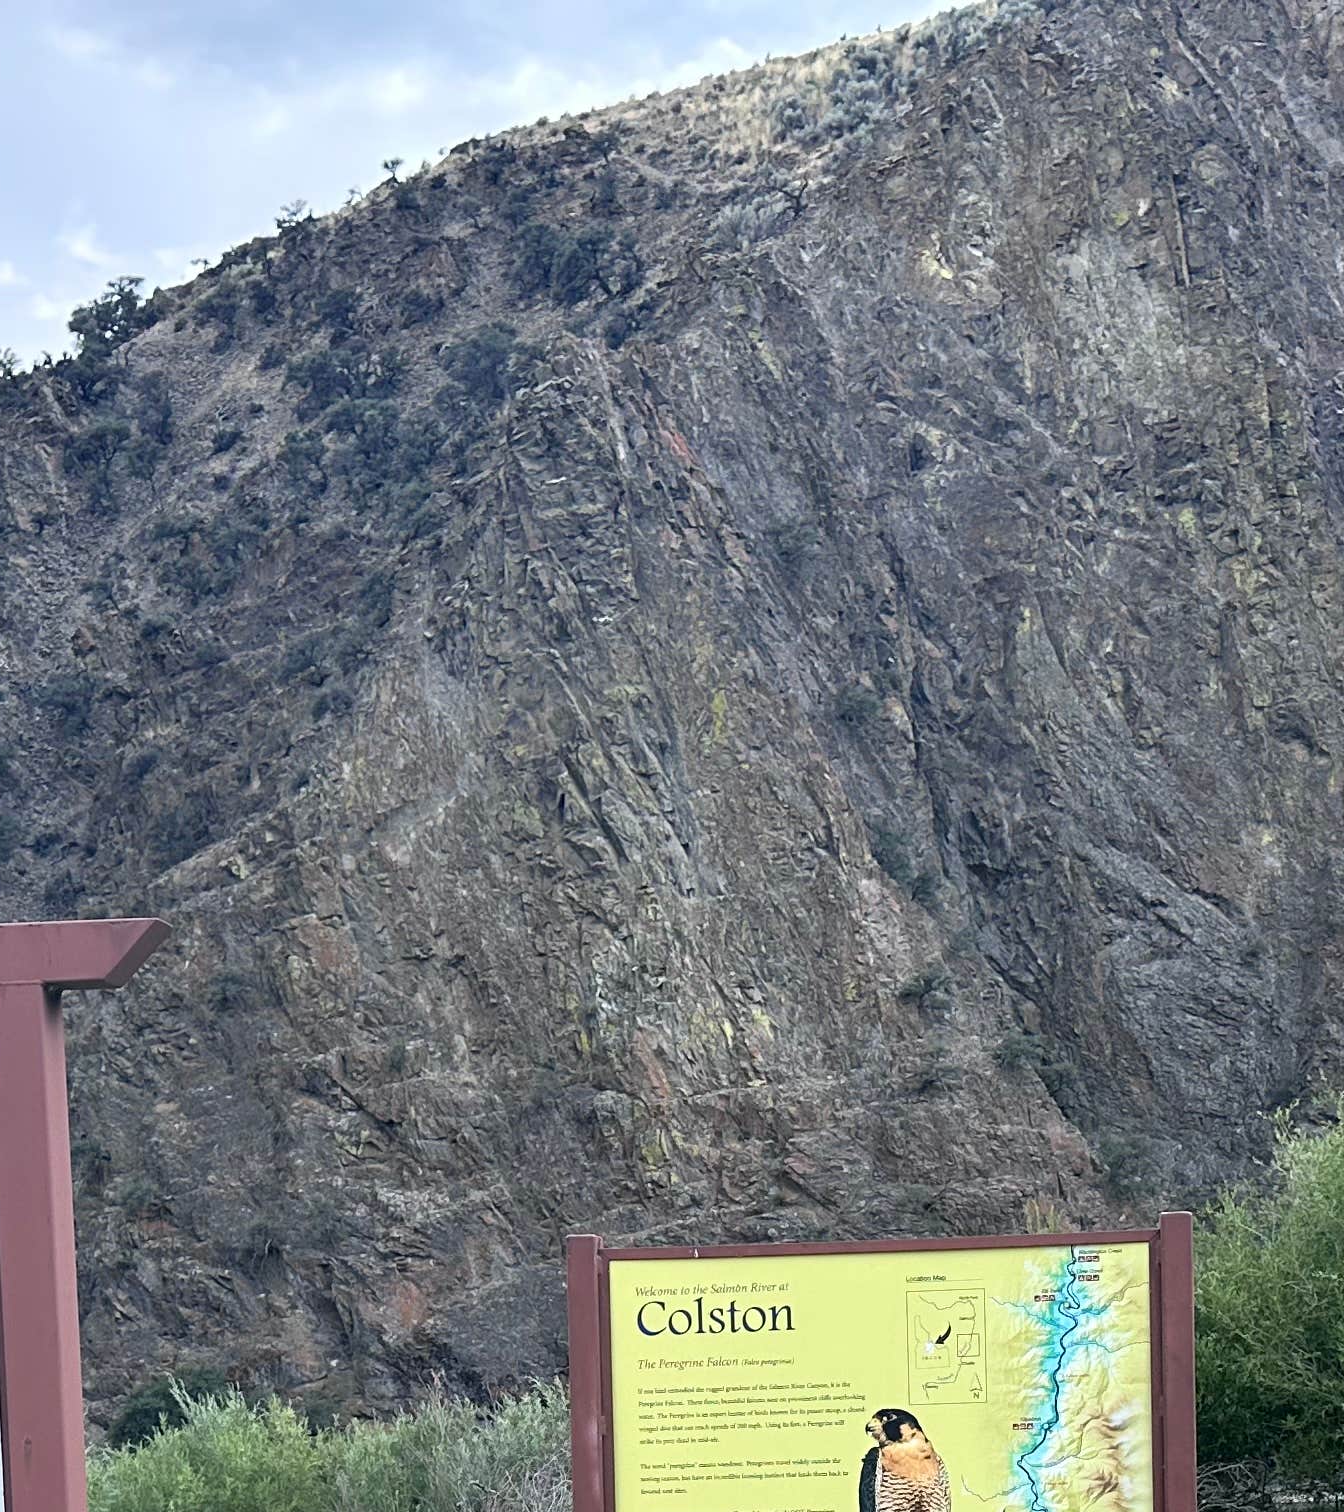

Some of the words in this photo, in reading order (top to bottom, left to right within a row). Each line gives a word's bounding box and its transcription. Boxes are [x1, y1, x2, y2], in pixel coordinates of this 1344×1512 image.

[636, 1286, 678, 1296] Welcome
[681, 1287, 690, 1295] to
[693, 1284, 708, 1294] the
[710, 1283, 747, 1294] Salmon
[751, 1282, 777, 1293] River
[779, 1283, 789, 1291] at
[637, 1297, 796, 1336] Colston
[638, 1360, 656, 1370] The
[659, 1359, 704, 1371] Peregrine
[707, 1357, 739, 1367] Falcon
